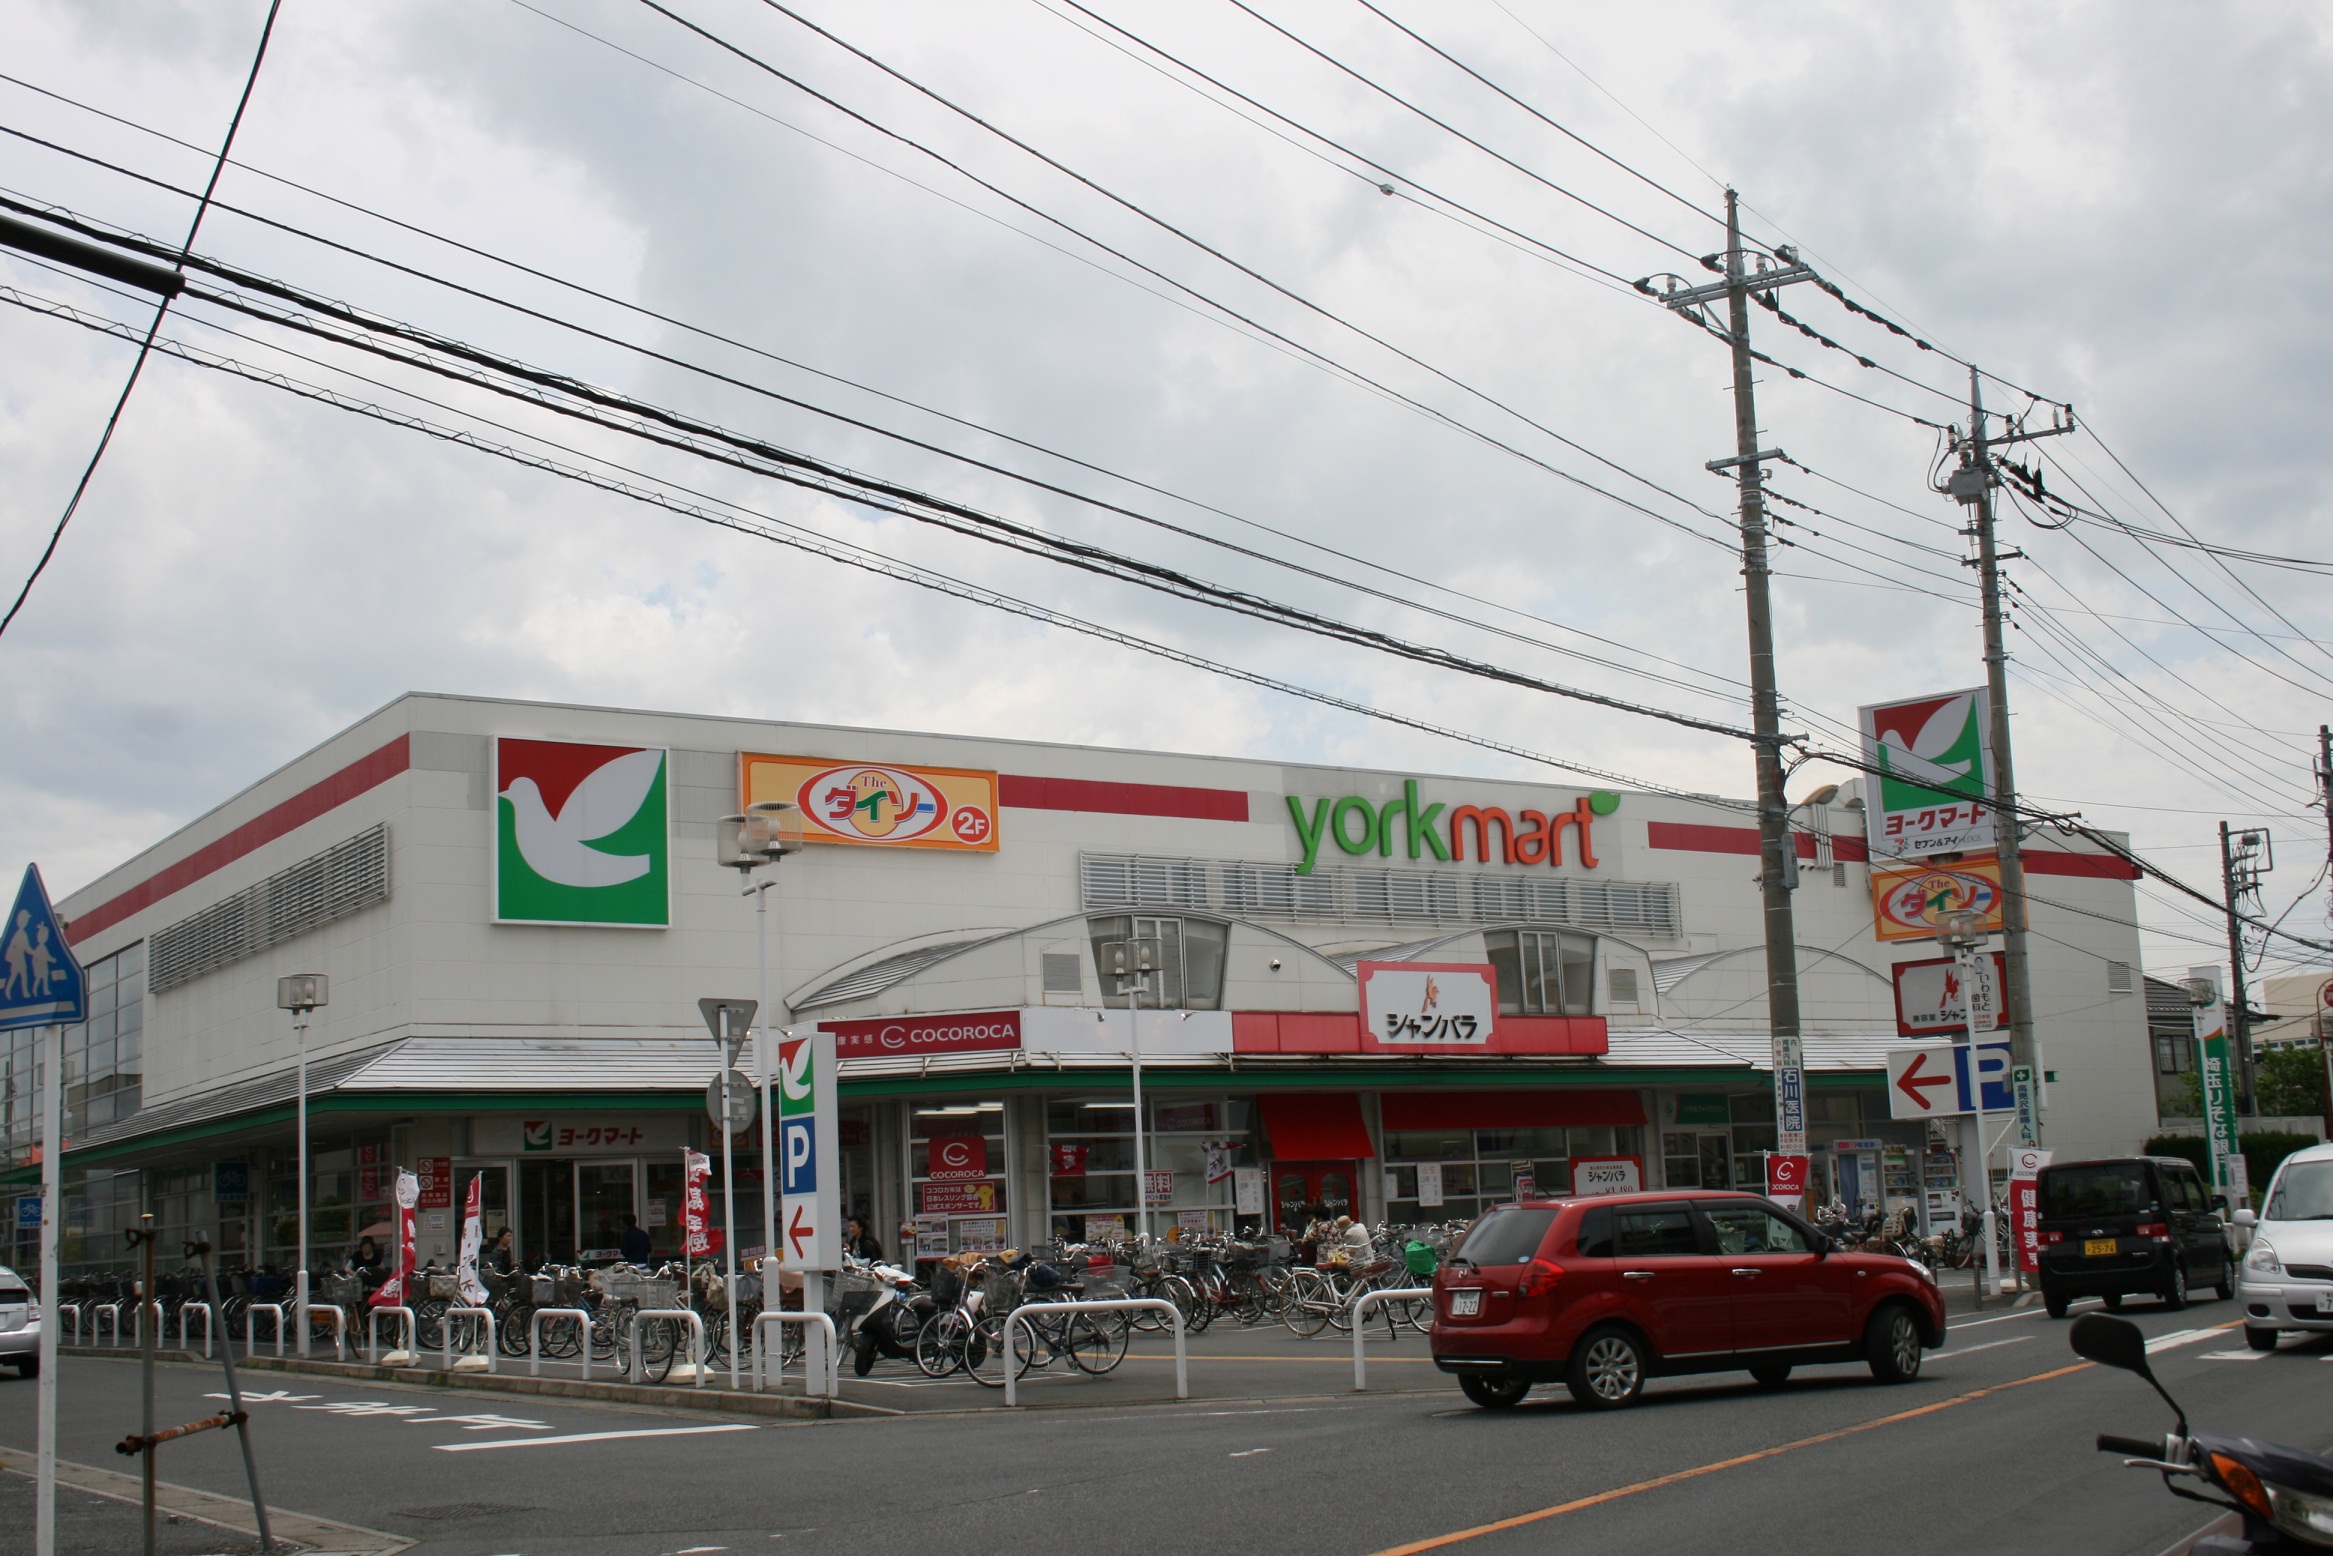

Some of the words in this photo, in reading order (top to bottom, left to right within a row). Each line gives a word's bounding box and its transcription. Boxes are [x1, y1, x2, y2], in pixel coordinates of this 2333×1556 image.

[861, 776, 888, 789] The
[824, 784, 936, 823] ダイソー
[957, 811, 986, 836] 2F
[1285, 779, 1600, 875] yorkmart
[1885, 803, 1987, 836] ヨークマート
[1914, 836, 1958, 850] セブン&アイ
[1929, 880, 1951, 889] The
[1901, 886, 1992, 919] ダイソー
[910, 1024, 1015, 1043] COCOROCA
[1386, 1014, 1478, 1039] シャンバラ
[1783, 1069, 1801, 1130] 石川医院
[558, 1127, 642, 1146] ヨークマート
[788, 1125, 810, 1188] P
[930, 1169, 985, 1179] COCOROCA
[1588, 1170, 1626, 1183] シャンバラ
